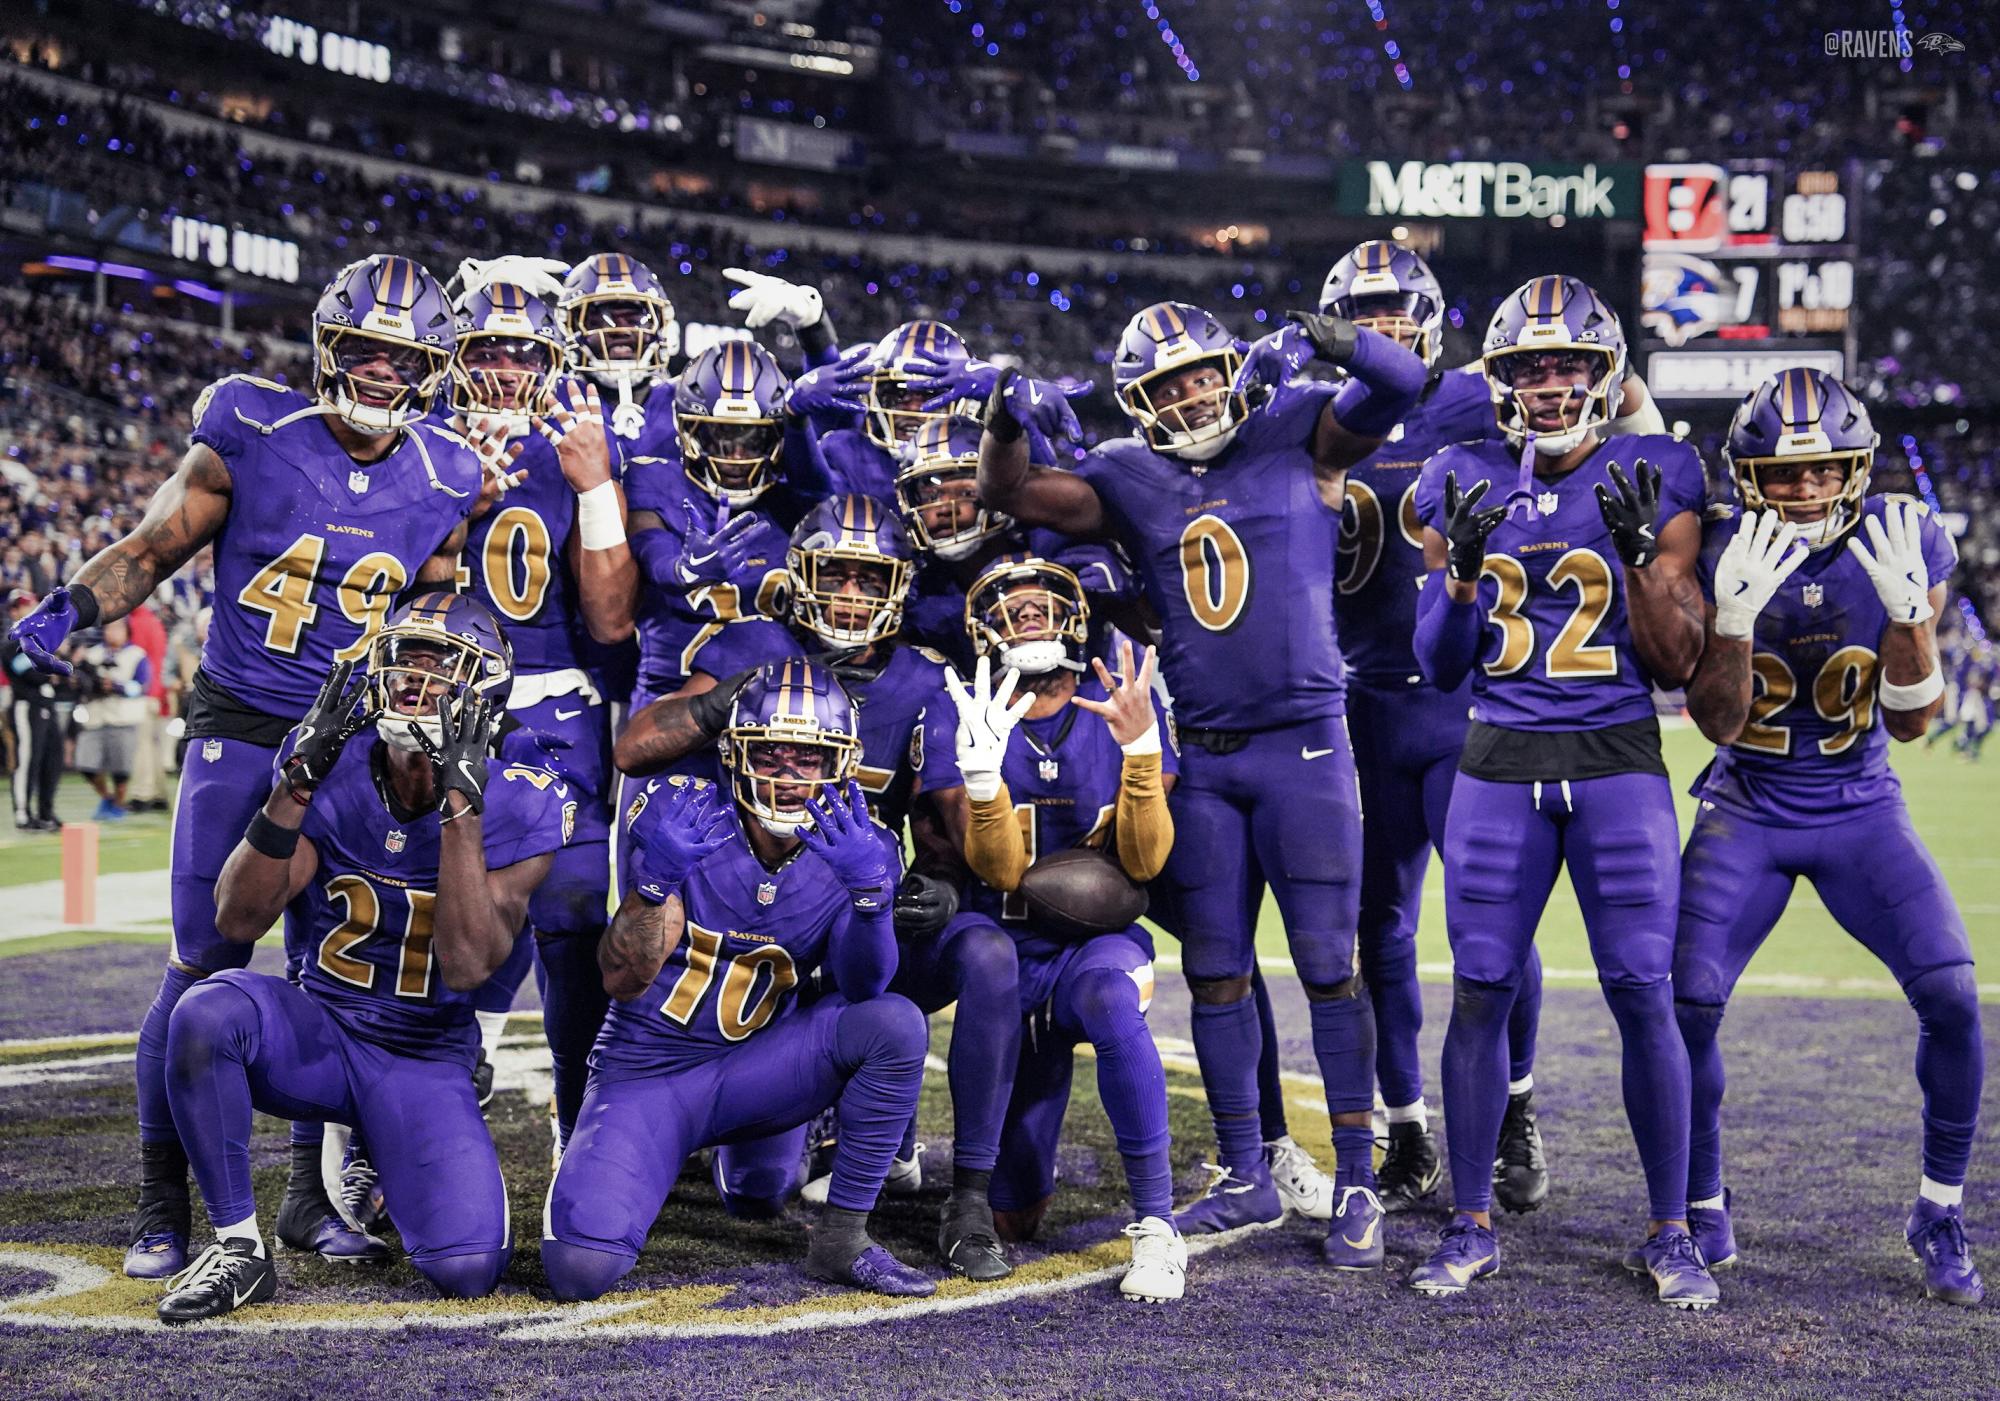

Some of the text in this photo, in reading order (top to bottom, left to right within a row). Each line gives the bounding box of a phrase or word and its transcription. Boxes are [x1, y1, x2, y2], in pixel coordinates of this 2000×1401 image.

[1366, 160, 1615, 218] M&T Bank
[1733, 266, 1759, 322] 7
[326, 523, 374, 538] RAVENS
[1180, 513, 1249, 632] 0
[1518, 541, 1569, 553] RAVENS
[238, 533, 407, 664] 49
[1479, 547, 1617, 678] 32
[1735, 645, 1878, 755] 29
[317, 874, 437, 998] 21
[659, 920, 798, 1041] 10
[727, 930, 776, 944] RAVENS
